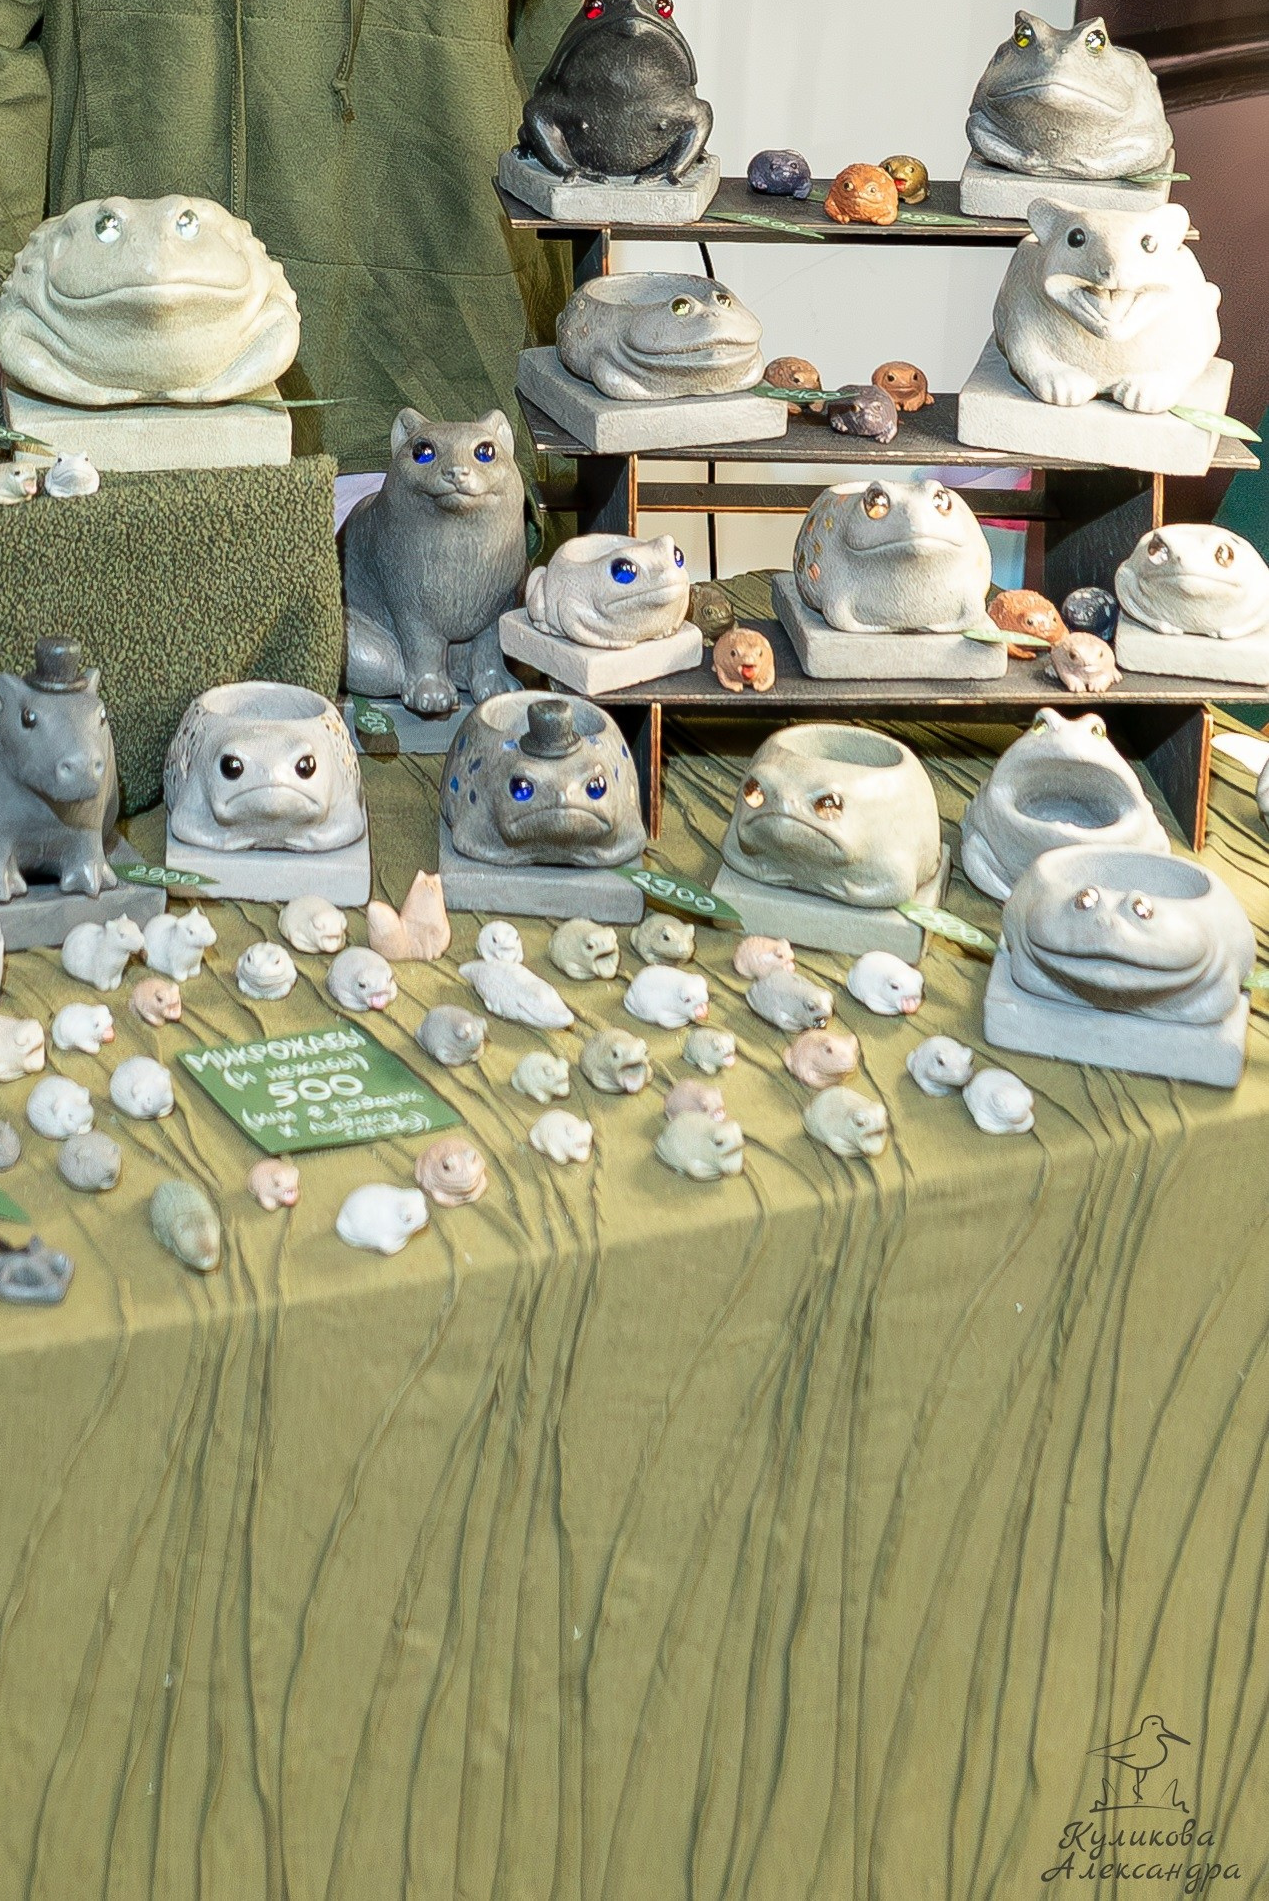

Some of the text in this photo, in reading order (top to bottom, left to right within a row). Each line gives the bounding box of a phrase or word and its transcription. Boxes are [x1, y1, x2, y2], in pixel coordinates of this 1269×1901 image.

[630, 870, 717, 913] 2900
[184, 1028, 367, 1073] МИКРОЖАБЫ
[267, 1073, 364, 1108] 500
